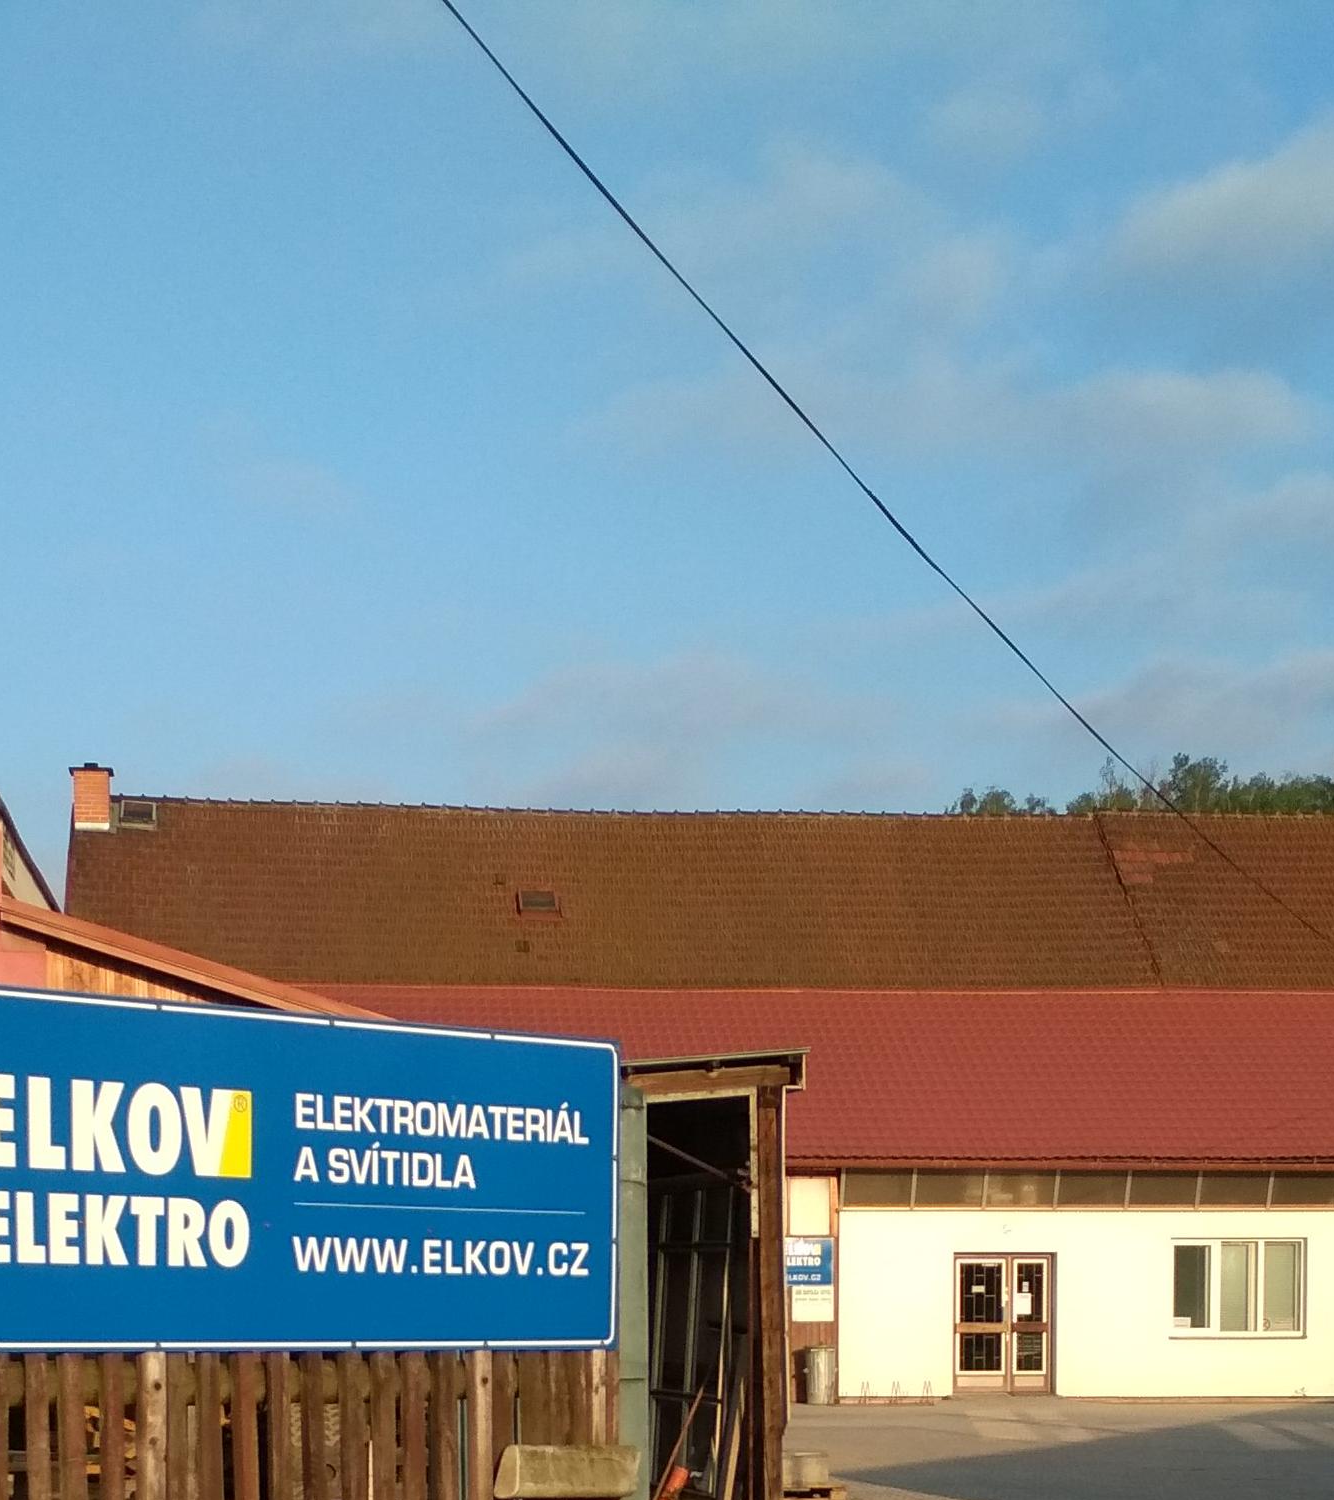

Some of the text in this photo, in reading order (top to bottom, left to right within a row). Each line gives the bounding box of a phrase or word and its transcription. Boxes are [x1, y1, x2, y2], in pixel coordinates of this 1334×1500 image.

[295, 1092, 590, 1145] ELEKTROMATERIÁL
[293, 1141, 477, 1189] A SVÍTIDLA
[292, 1235, 590, 1276] WWW.ELKOV.CZ
